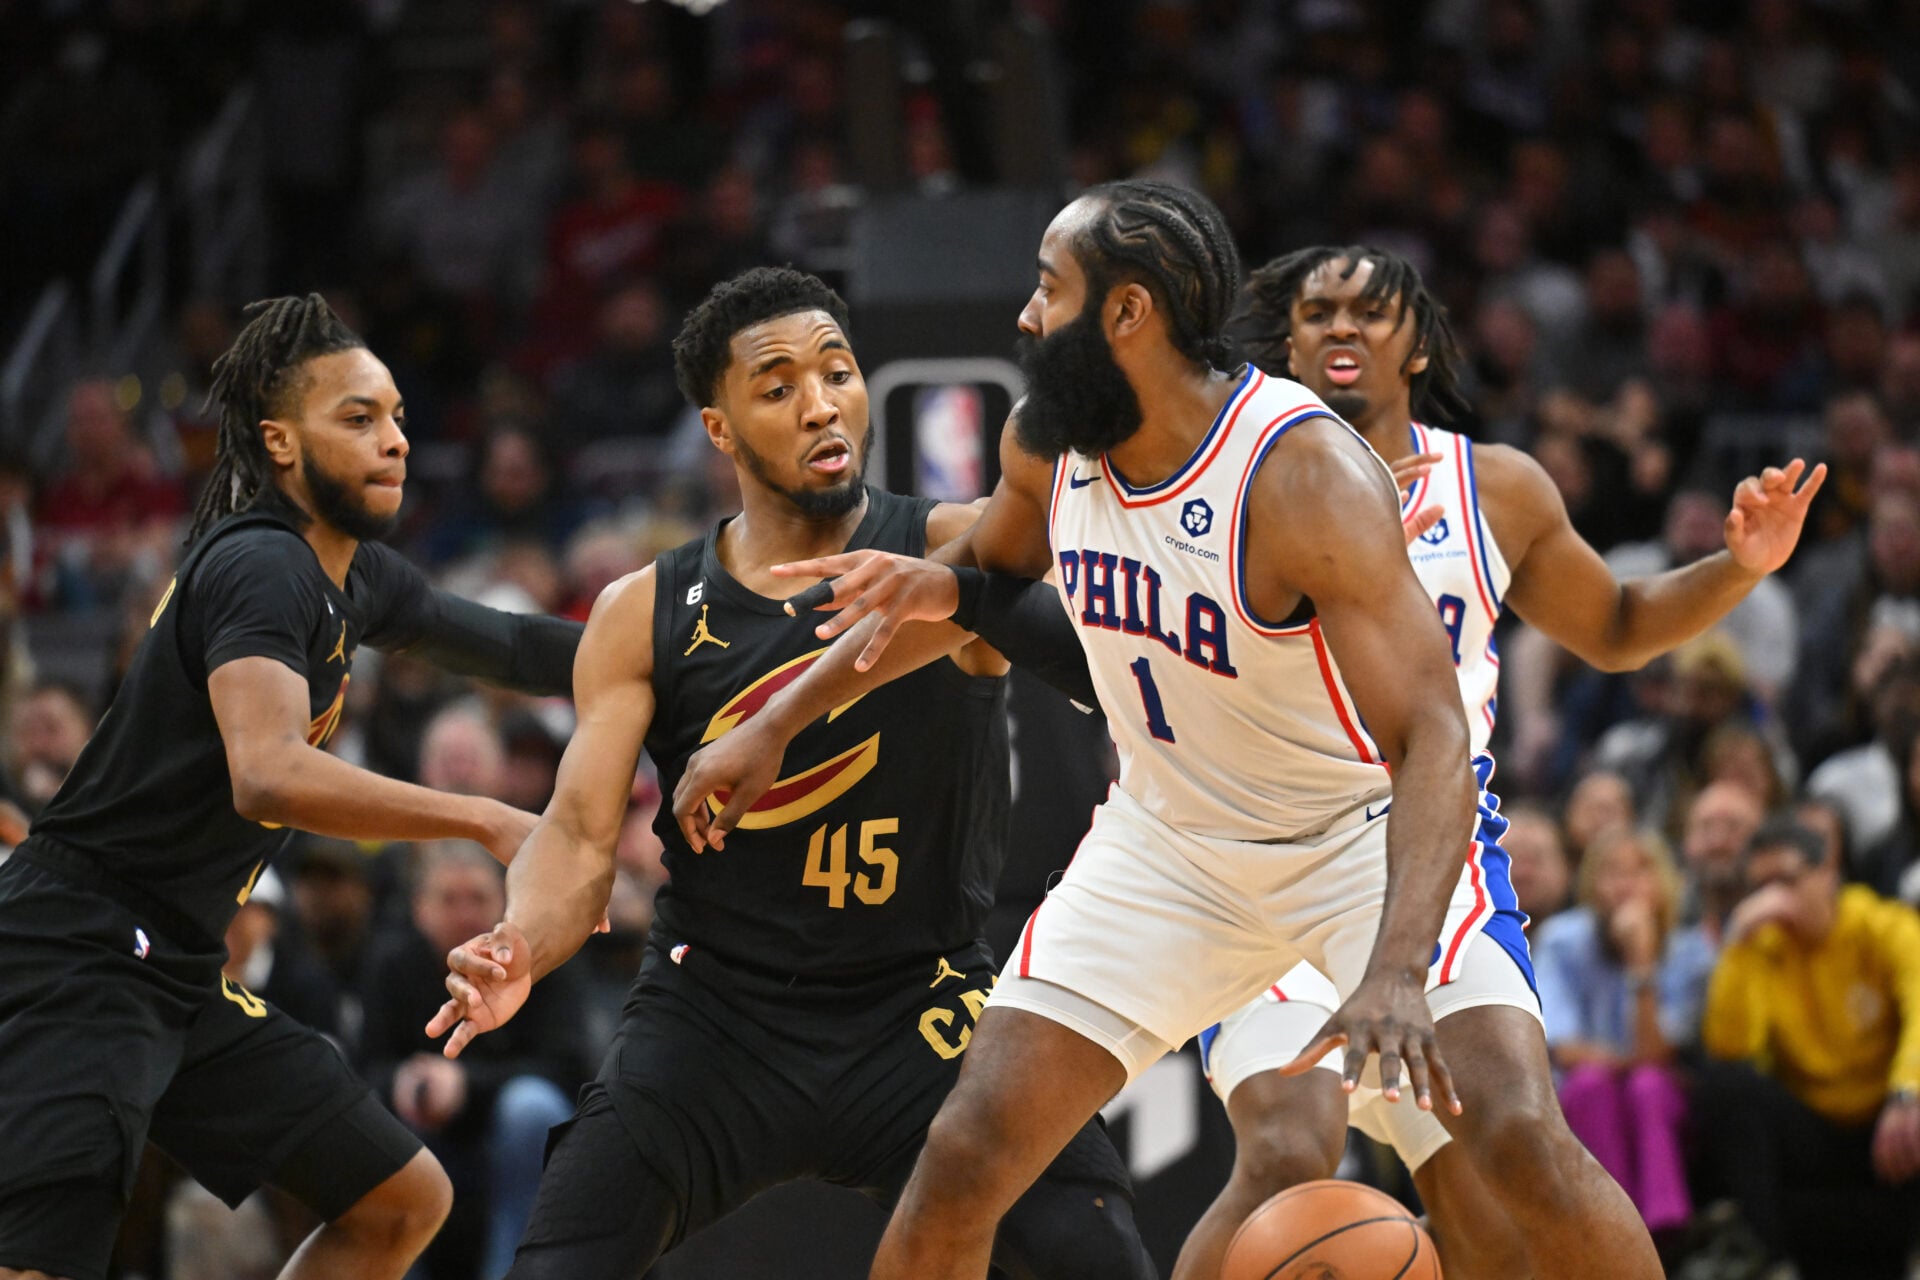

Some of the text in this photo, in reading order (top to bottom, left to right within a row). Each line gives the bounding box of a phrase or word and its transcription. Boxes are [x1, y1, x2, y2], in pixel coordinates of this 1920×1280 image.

[1164, 534, 1220, 563] crypto.com
[686, 582, 704, 605] 6
[1058, 548, 1239, 680] PHILA
[1129, 656, 1176, 744] 1
[801, 816, 900, 909] 45
